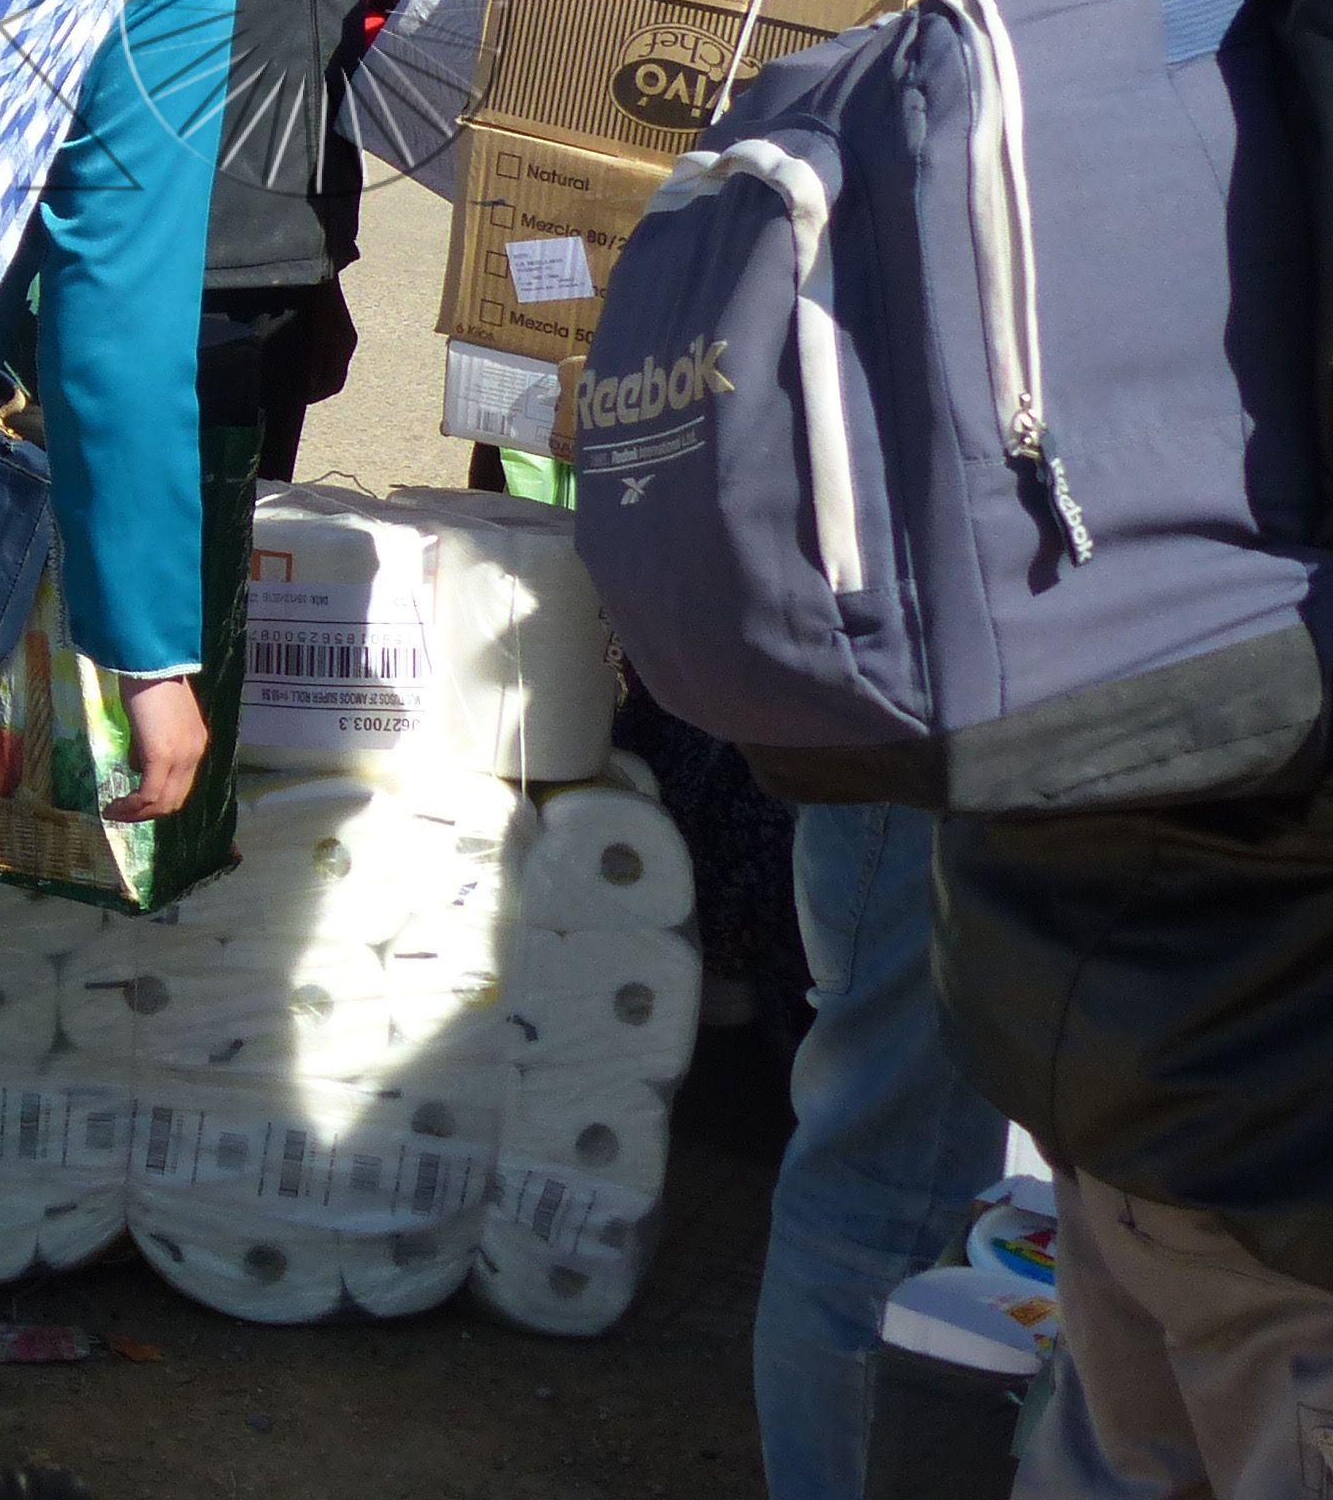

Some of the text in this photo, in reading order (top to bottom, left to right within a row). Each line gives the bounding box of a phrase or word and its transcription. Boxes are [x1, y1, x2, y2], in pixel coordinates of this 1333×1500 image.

[638, 30, 726, 73] Chef
[526, 163, 590, 192] Natural
[520, 212, 582, 238] Mezcla
[509, 310, 570, 339] Mezcla
[575, 336, 735, 429] Reebok
[291, 689, 310, 702] ROLL
[311, 690, 337, 703] SUPER
